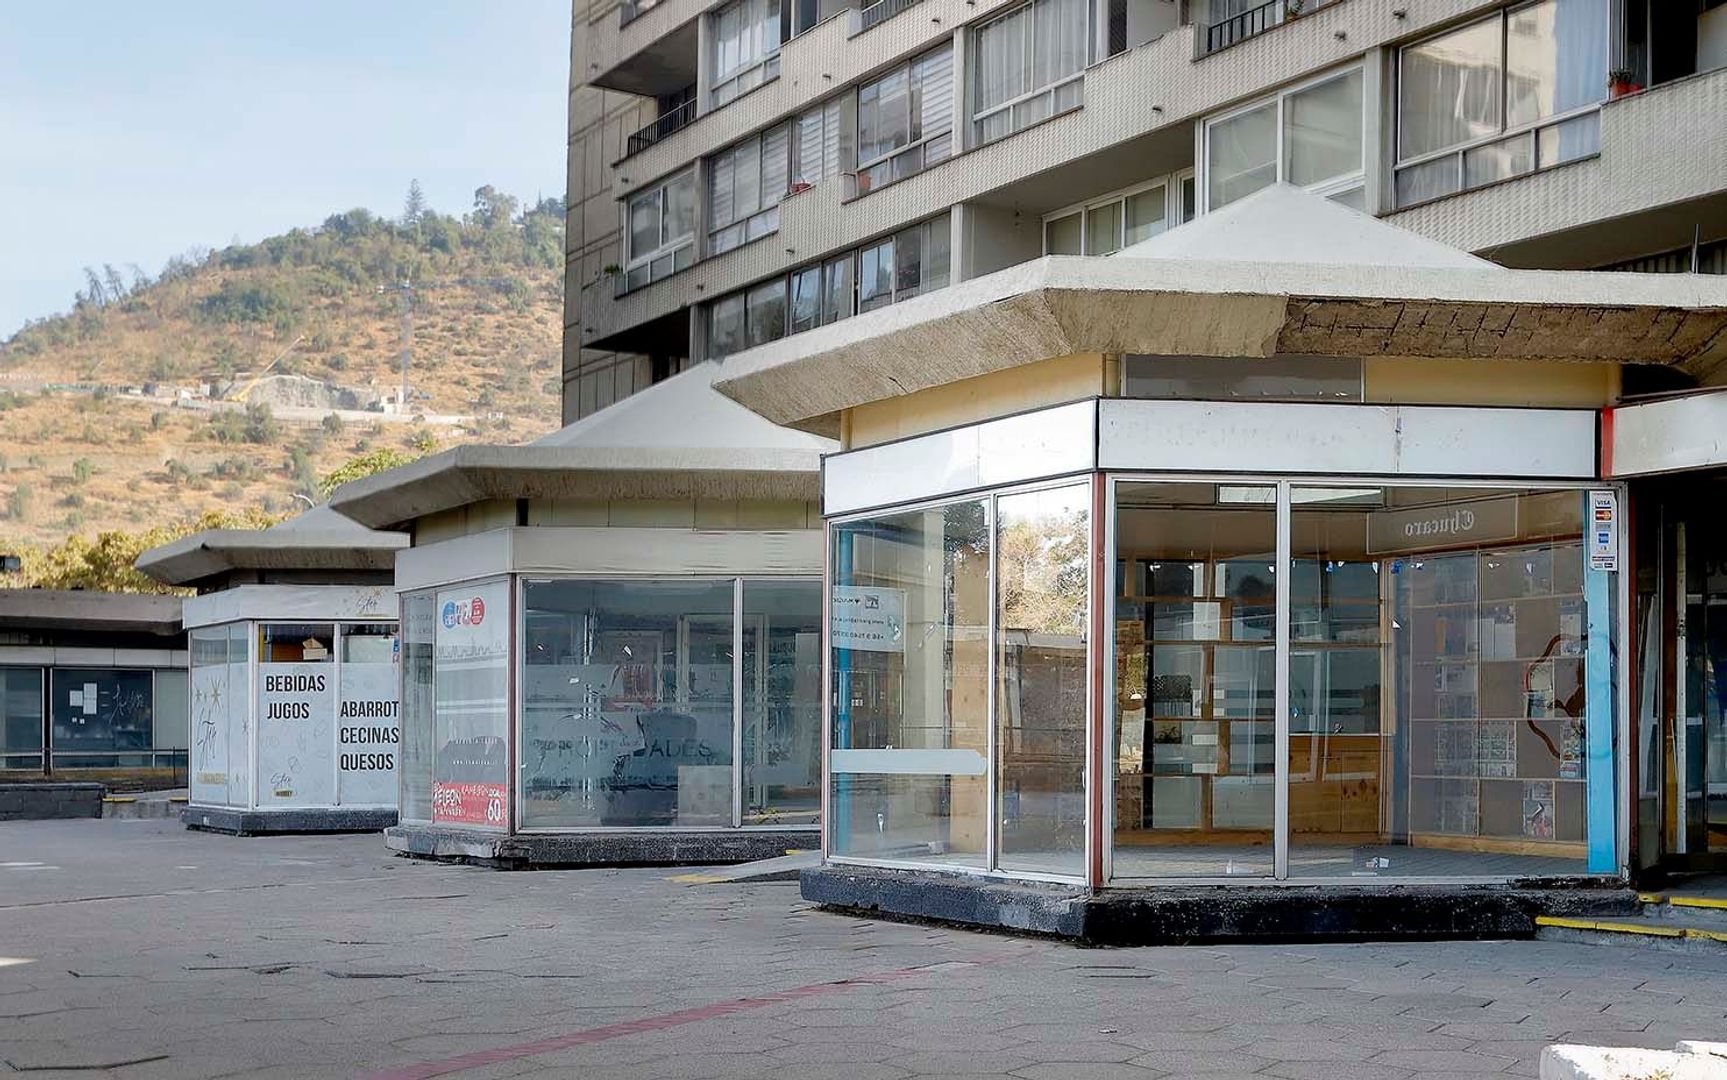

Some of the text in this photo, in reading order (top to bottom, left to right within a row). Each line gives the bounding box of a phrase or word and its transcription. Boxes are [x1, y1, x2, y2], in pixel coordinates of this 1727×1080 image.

[265, 675, 326, 693] BEBIDAS
[266, 702, 310, 720] JUGOS
[340, 700, 399, 718] ABARROT
[340, 727, 399, 744] CECINAS
[340, 753, 394, 771] QUESOS
